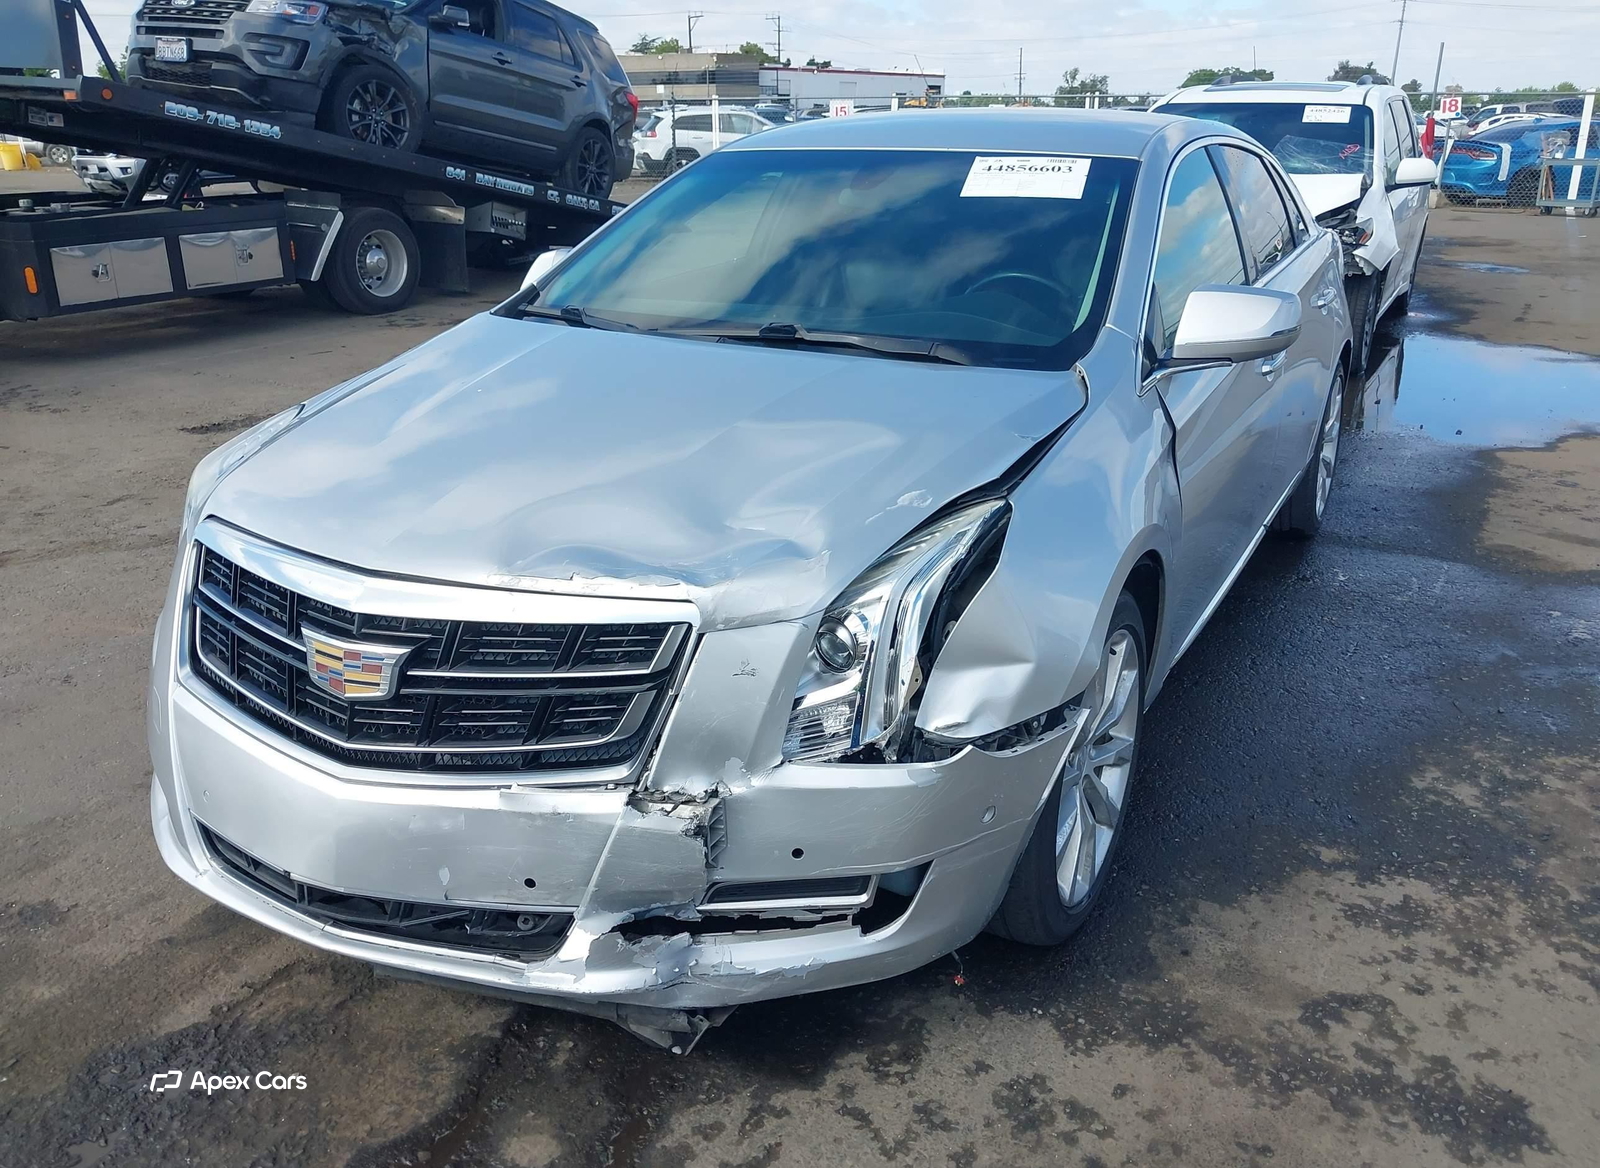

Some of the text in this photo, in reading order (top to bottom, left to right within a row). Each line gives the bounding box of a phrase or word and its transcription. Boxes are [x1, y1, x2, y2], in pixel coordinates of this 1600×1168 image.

[835, 106, 847, 117] 15
[1442, 98, 1459, 114] 18
[982, 164, 1073, 174] 44856603
